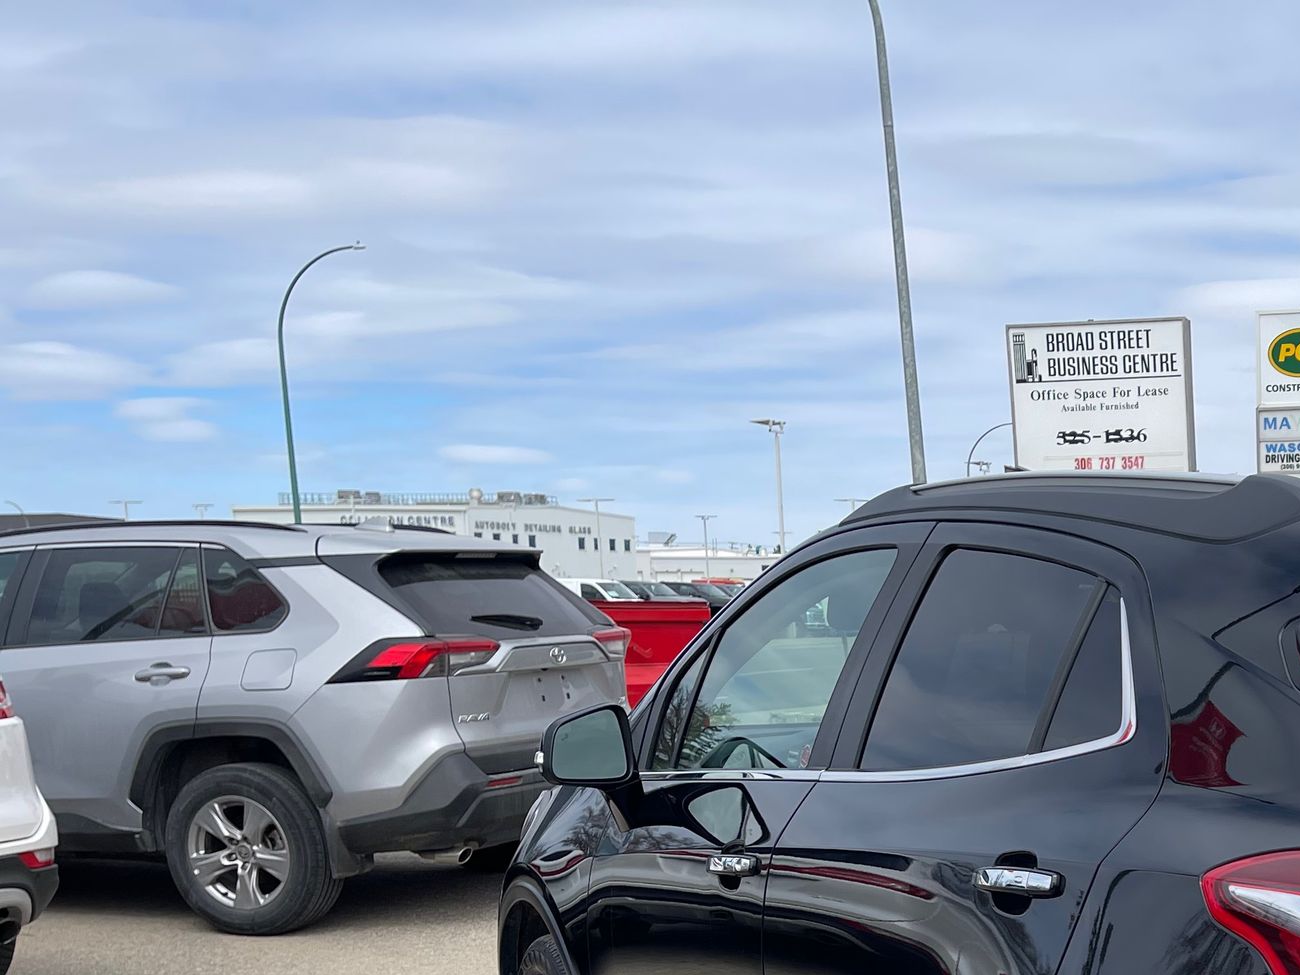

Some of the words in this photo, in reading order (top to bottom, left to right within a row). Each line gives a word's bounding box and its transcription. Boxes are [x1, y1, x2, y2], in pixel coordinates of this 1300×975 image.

[1046, 331, 1095, 353] BROAD
[1099, 328, 1152, 350] STREET
[1047, 355, 1118, 377] BUSINESS
[1122, 352, 1178, 374] CENTRE
[1030, 388, 1069, 401] Office
[1074, 387, 1107, 401] Space
[1112, 386, 1131, 398] For
[1137, 385, 1169, 397] Lease
[1061, 403, 1096, 413] Available
[1100, 401, 1139, 411] Furnished
[1074, 457, 1092, 470] 306
[1099, 456, 1116, 470] 737
[1121, 455, 1145, 470] 3547
[1265, 453, 1300, 464] DRIVING
[408, 515, 456, 527] CENTRE
[524, 523, 562, 533] DETAILING
[568, 525, 591, 535] GLASS
